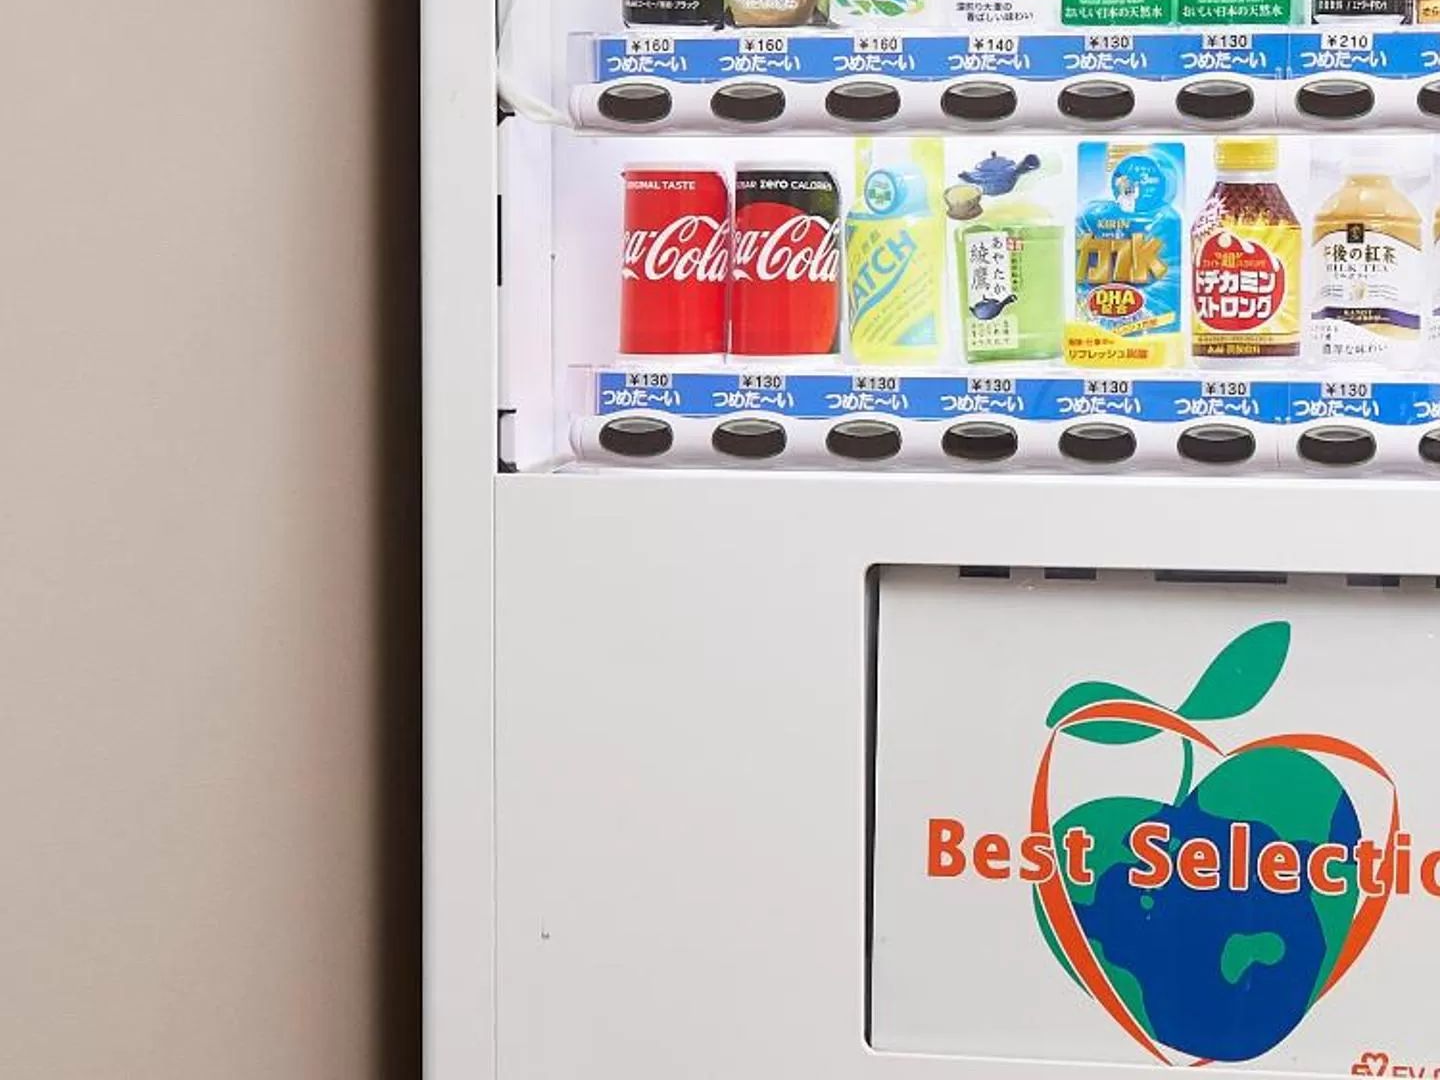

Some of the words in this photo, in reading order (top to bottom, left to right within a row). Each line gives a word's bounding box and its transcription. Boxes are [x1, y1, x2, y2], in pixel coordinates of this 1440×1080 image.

[631, 38, 669, 52] ¥160
[745, 38, 784, 52] ¥160
[859, 37, 898, 51] ¥160
[974, 37, 1013, 52] ¥140
[1089, 35, 1129, 50] ¥130
[1207, 34, 1247, 48] ¥130
[1326, 35, 1368, 48] ¥210
[662, 181, 695, 190] TASTE
[1096, 290, 1136, 305] DHA
[1198, 296, 1272, 319] ストロング
[629, 373, 669, 386] ¥130
[743, 375, 782, 388] ¥130
[857, 376, 896, 390] ¥130
[972, 378, 1011, 392] ¥130
[1088, 379, 1129, 394] ¥130
[1207, 381, 1247, 396] ¥130
[1327, 383, 1367, 397] ¥130
[928, 818, 1094, 882] Best
